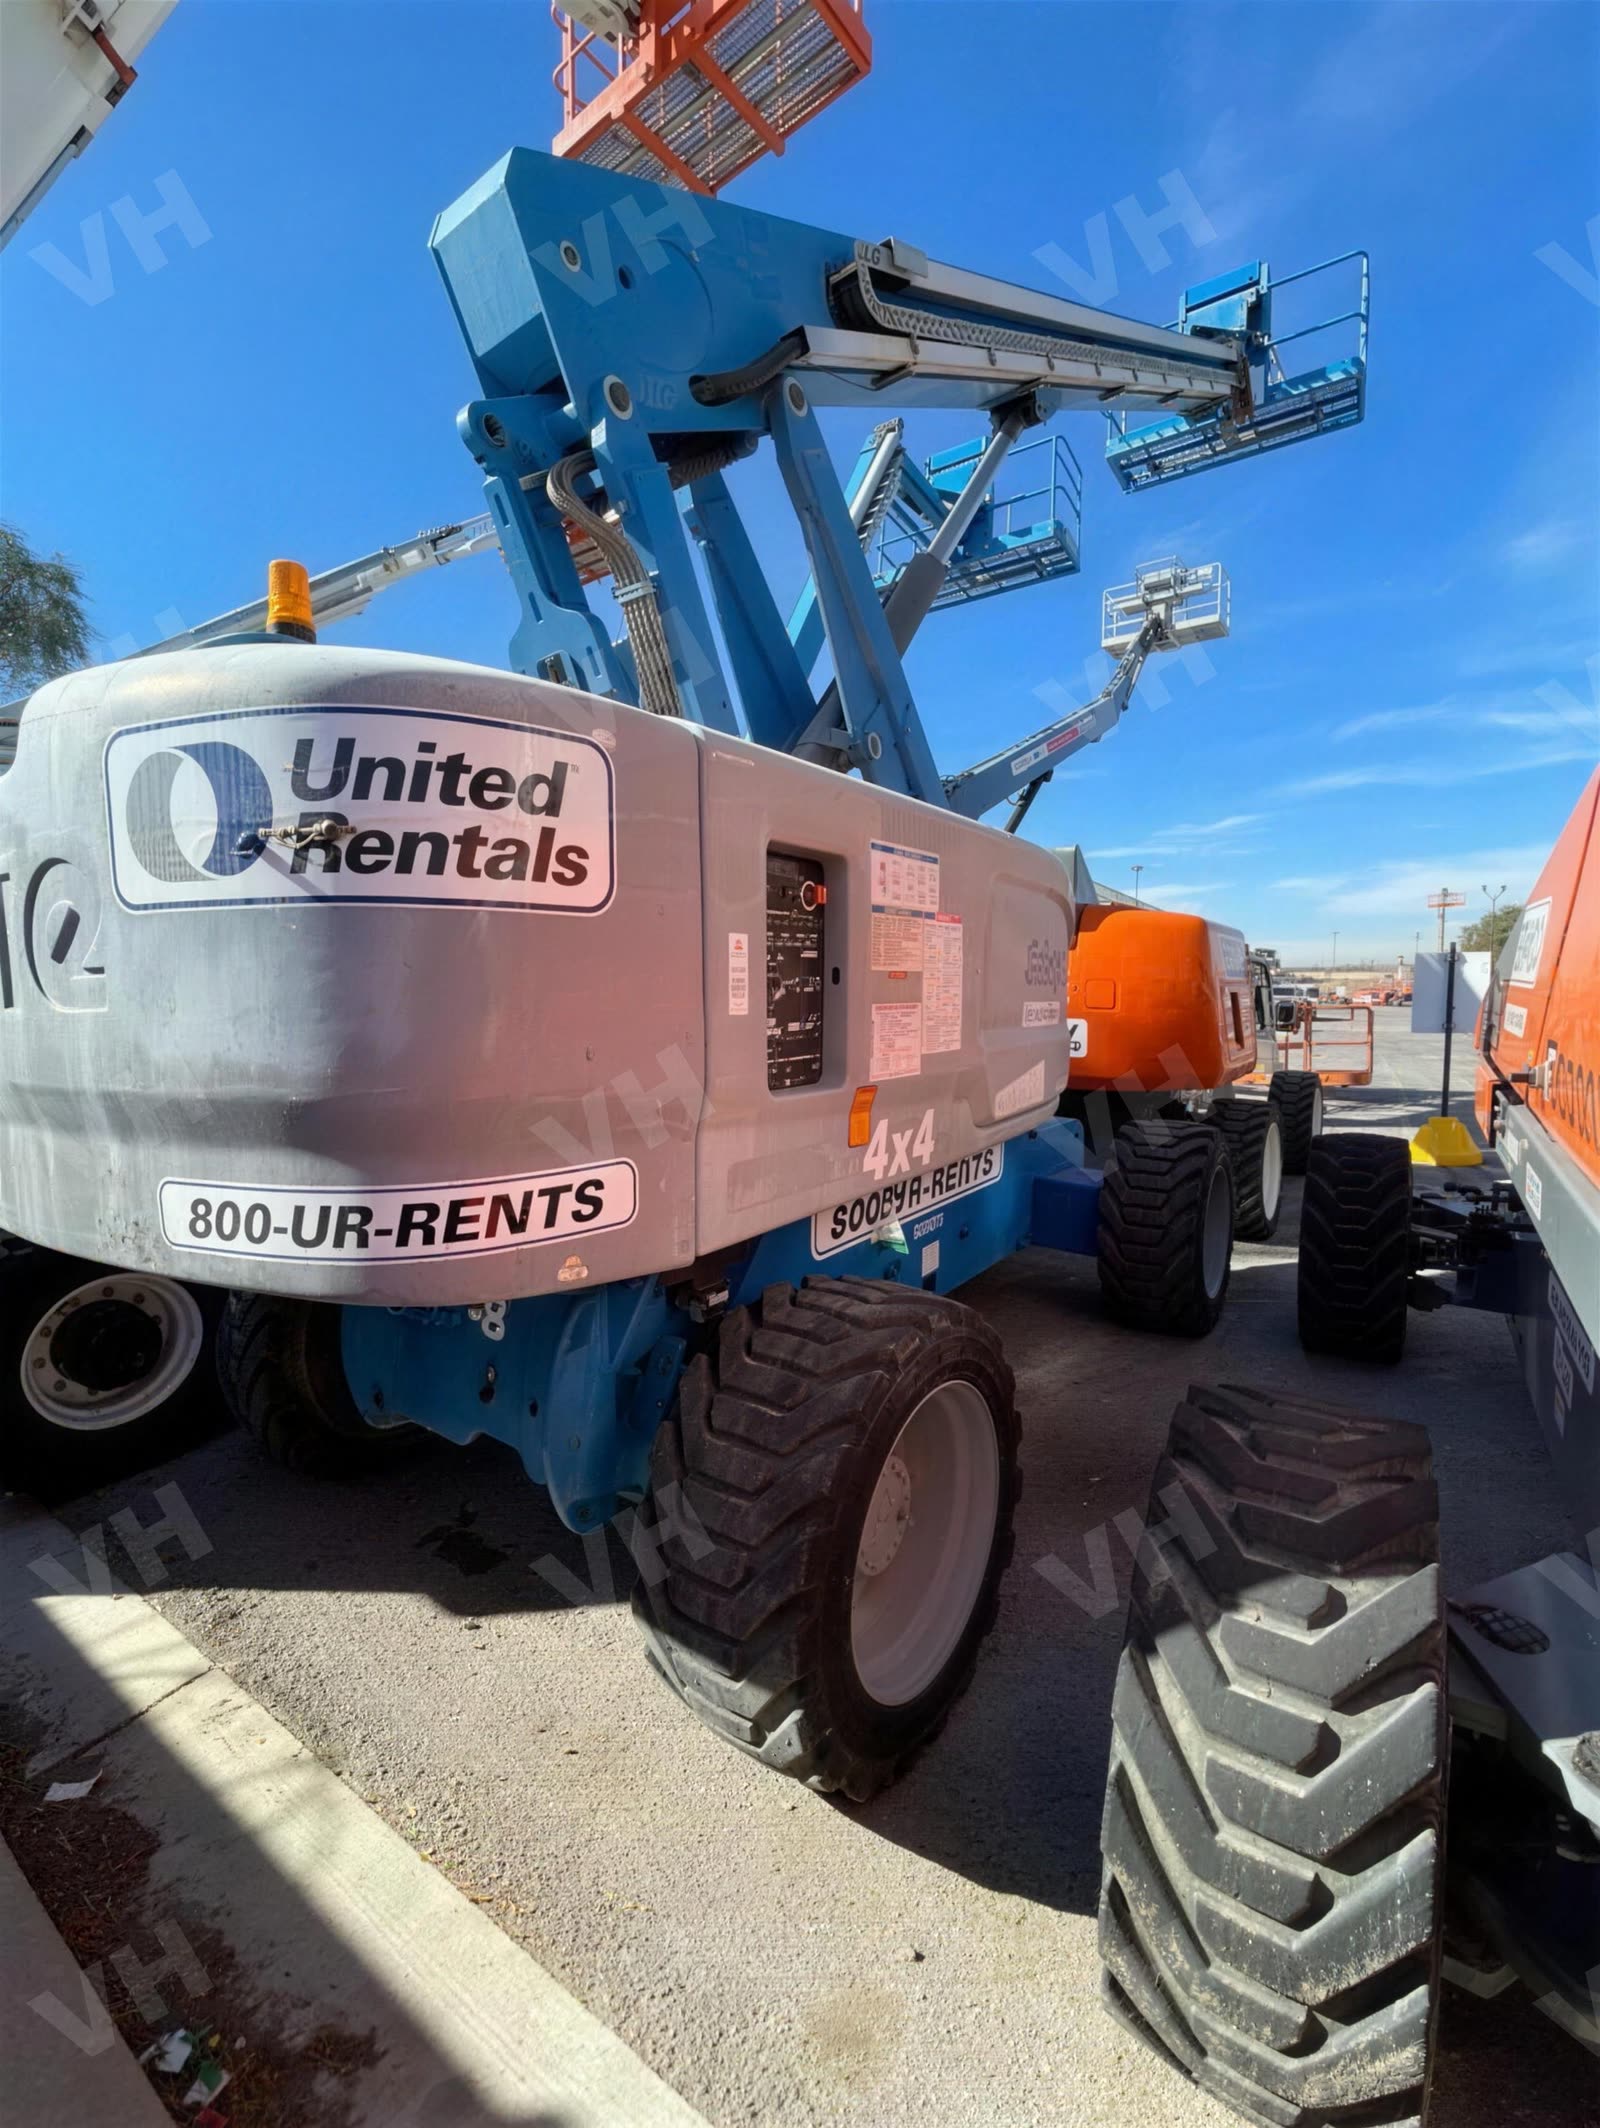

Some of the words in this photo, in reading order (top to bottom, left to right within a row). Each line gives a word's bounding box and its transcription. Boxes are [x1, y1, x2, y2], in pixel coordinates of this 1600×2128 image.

[290, 737, 568, 818] United
[289, 811, 590, 887] Rentals
[862, 1108, 935, 1181] 4x4
[188, 1178, 605, 1249] 800-UR-RENTS
